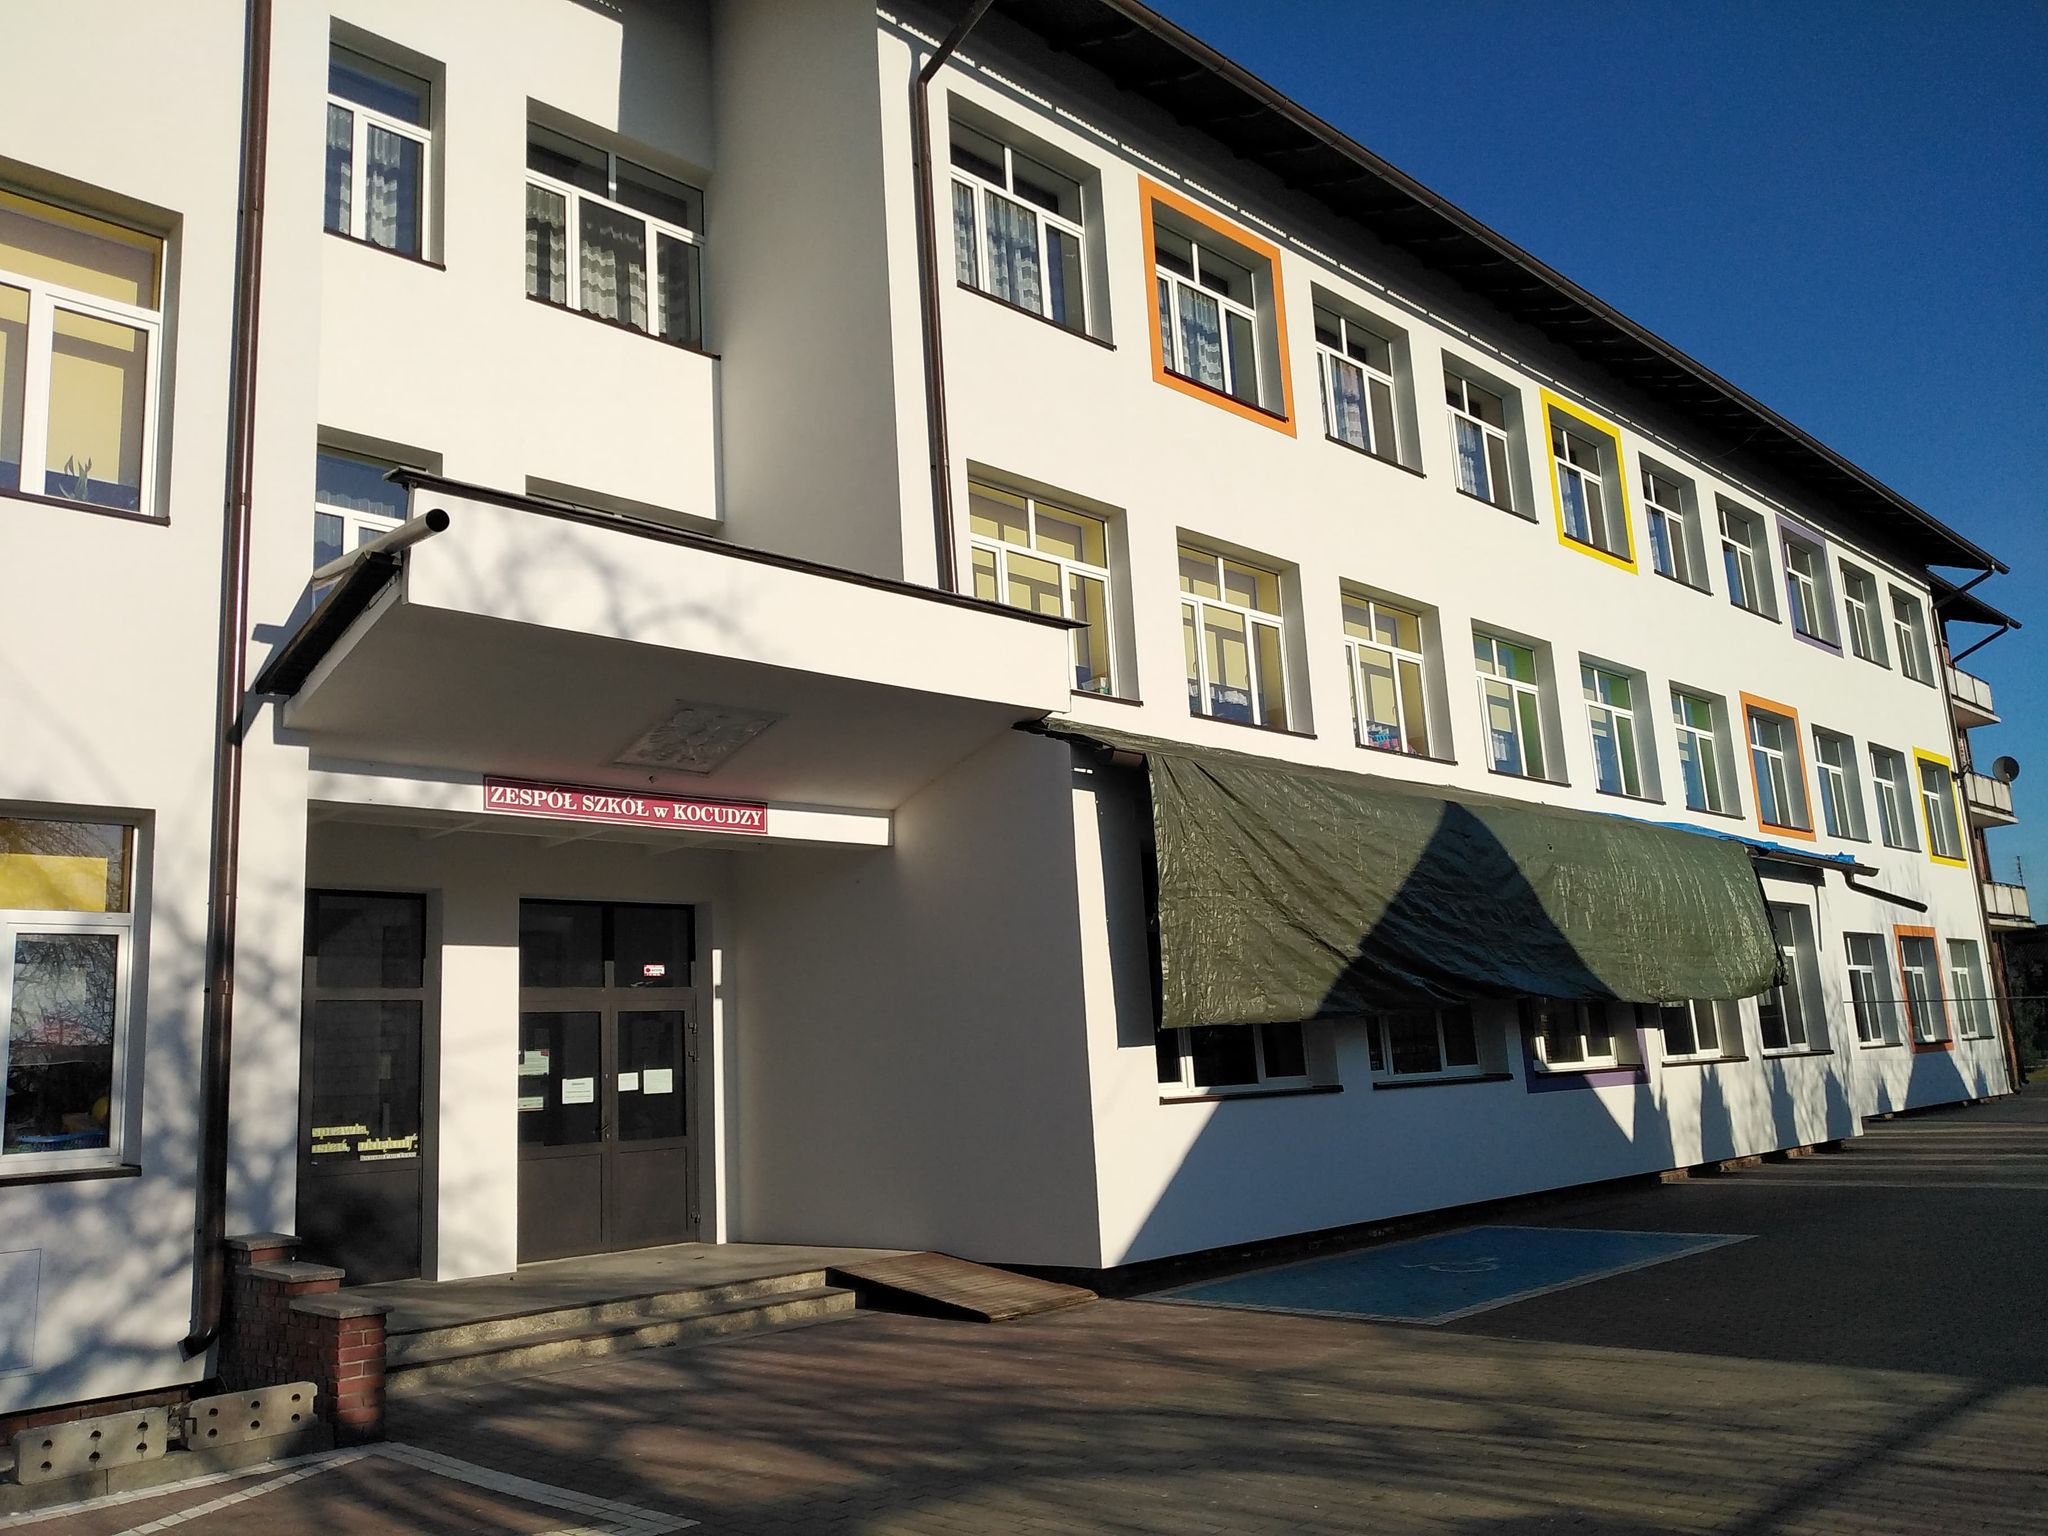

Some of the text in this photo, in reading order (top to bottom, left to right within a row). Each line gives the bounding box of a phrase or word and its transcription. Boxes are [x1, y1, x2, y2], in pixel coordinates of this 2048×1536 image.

[491, 786, 762, 826] ZESPÓŁ SZKÓŁ w KOCUDZY
